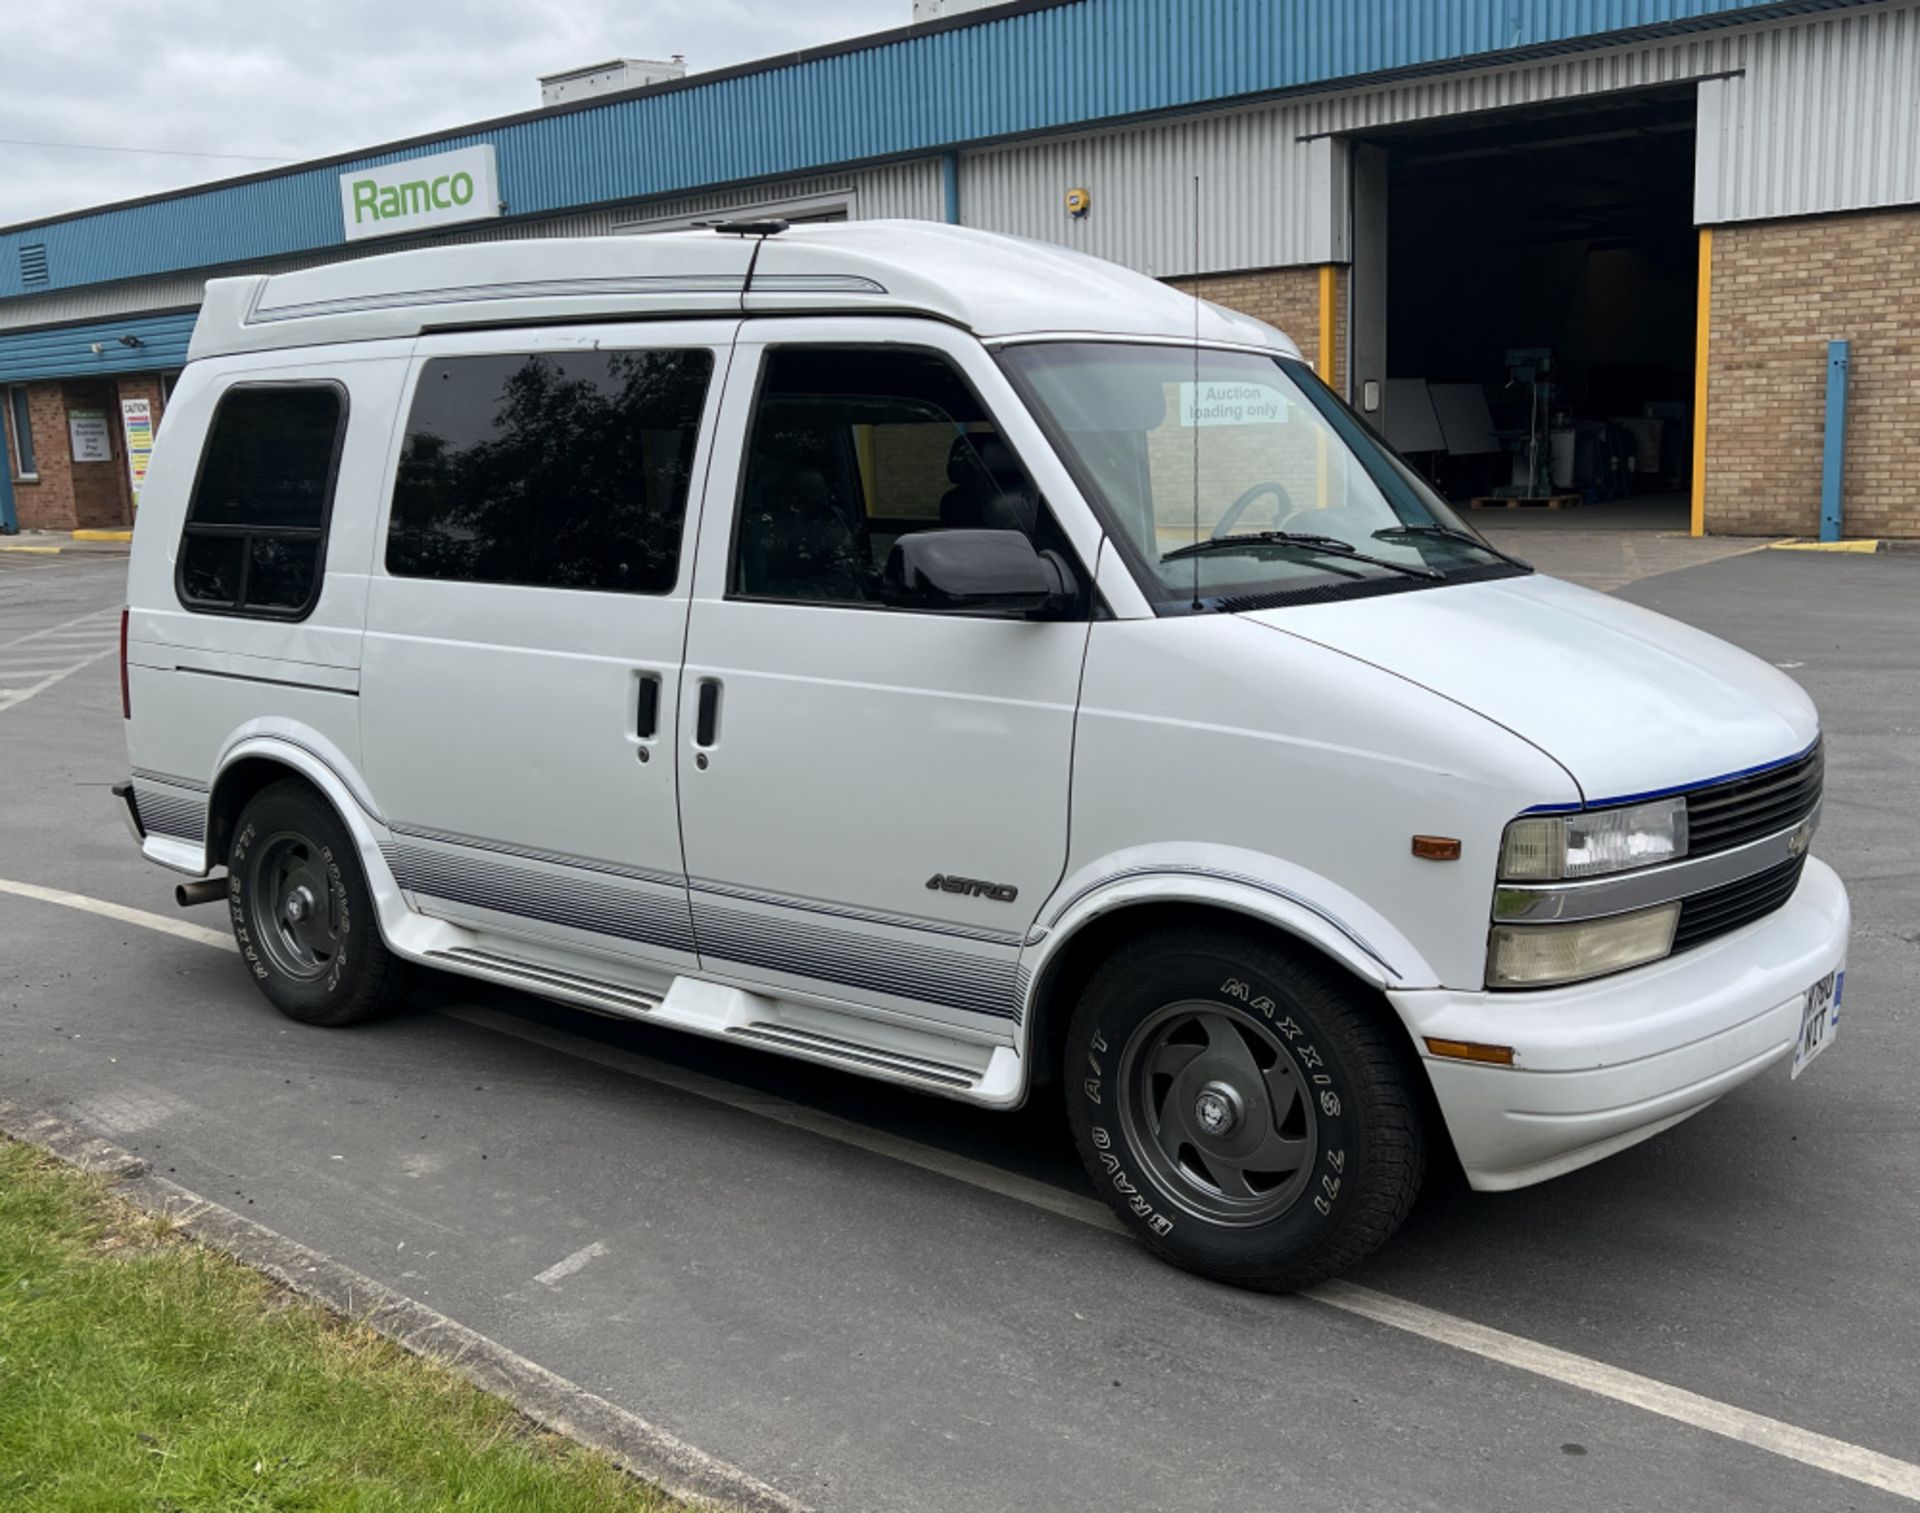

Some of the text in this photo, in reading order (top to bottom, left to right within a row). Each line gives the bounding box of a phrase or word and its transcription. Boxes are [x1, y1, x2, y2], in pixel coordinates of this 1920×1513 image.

[353, 171, 473, 223] Ramco
[1189, 402, 1278, 420] loading only
[1204, 386, 1260, 401] Auction
[925, 873, 1018, 903] ASTRO
[1221, 978, 1345, 1216] MAXXIS 771
[1084, 1029, 1174, 1237] BRAVO A/T
